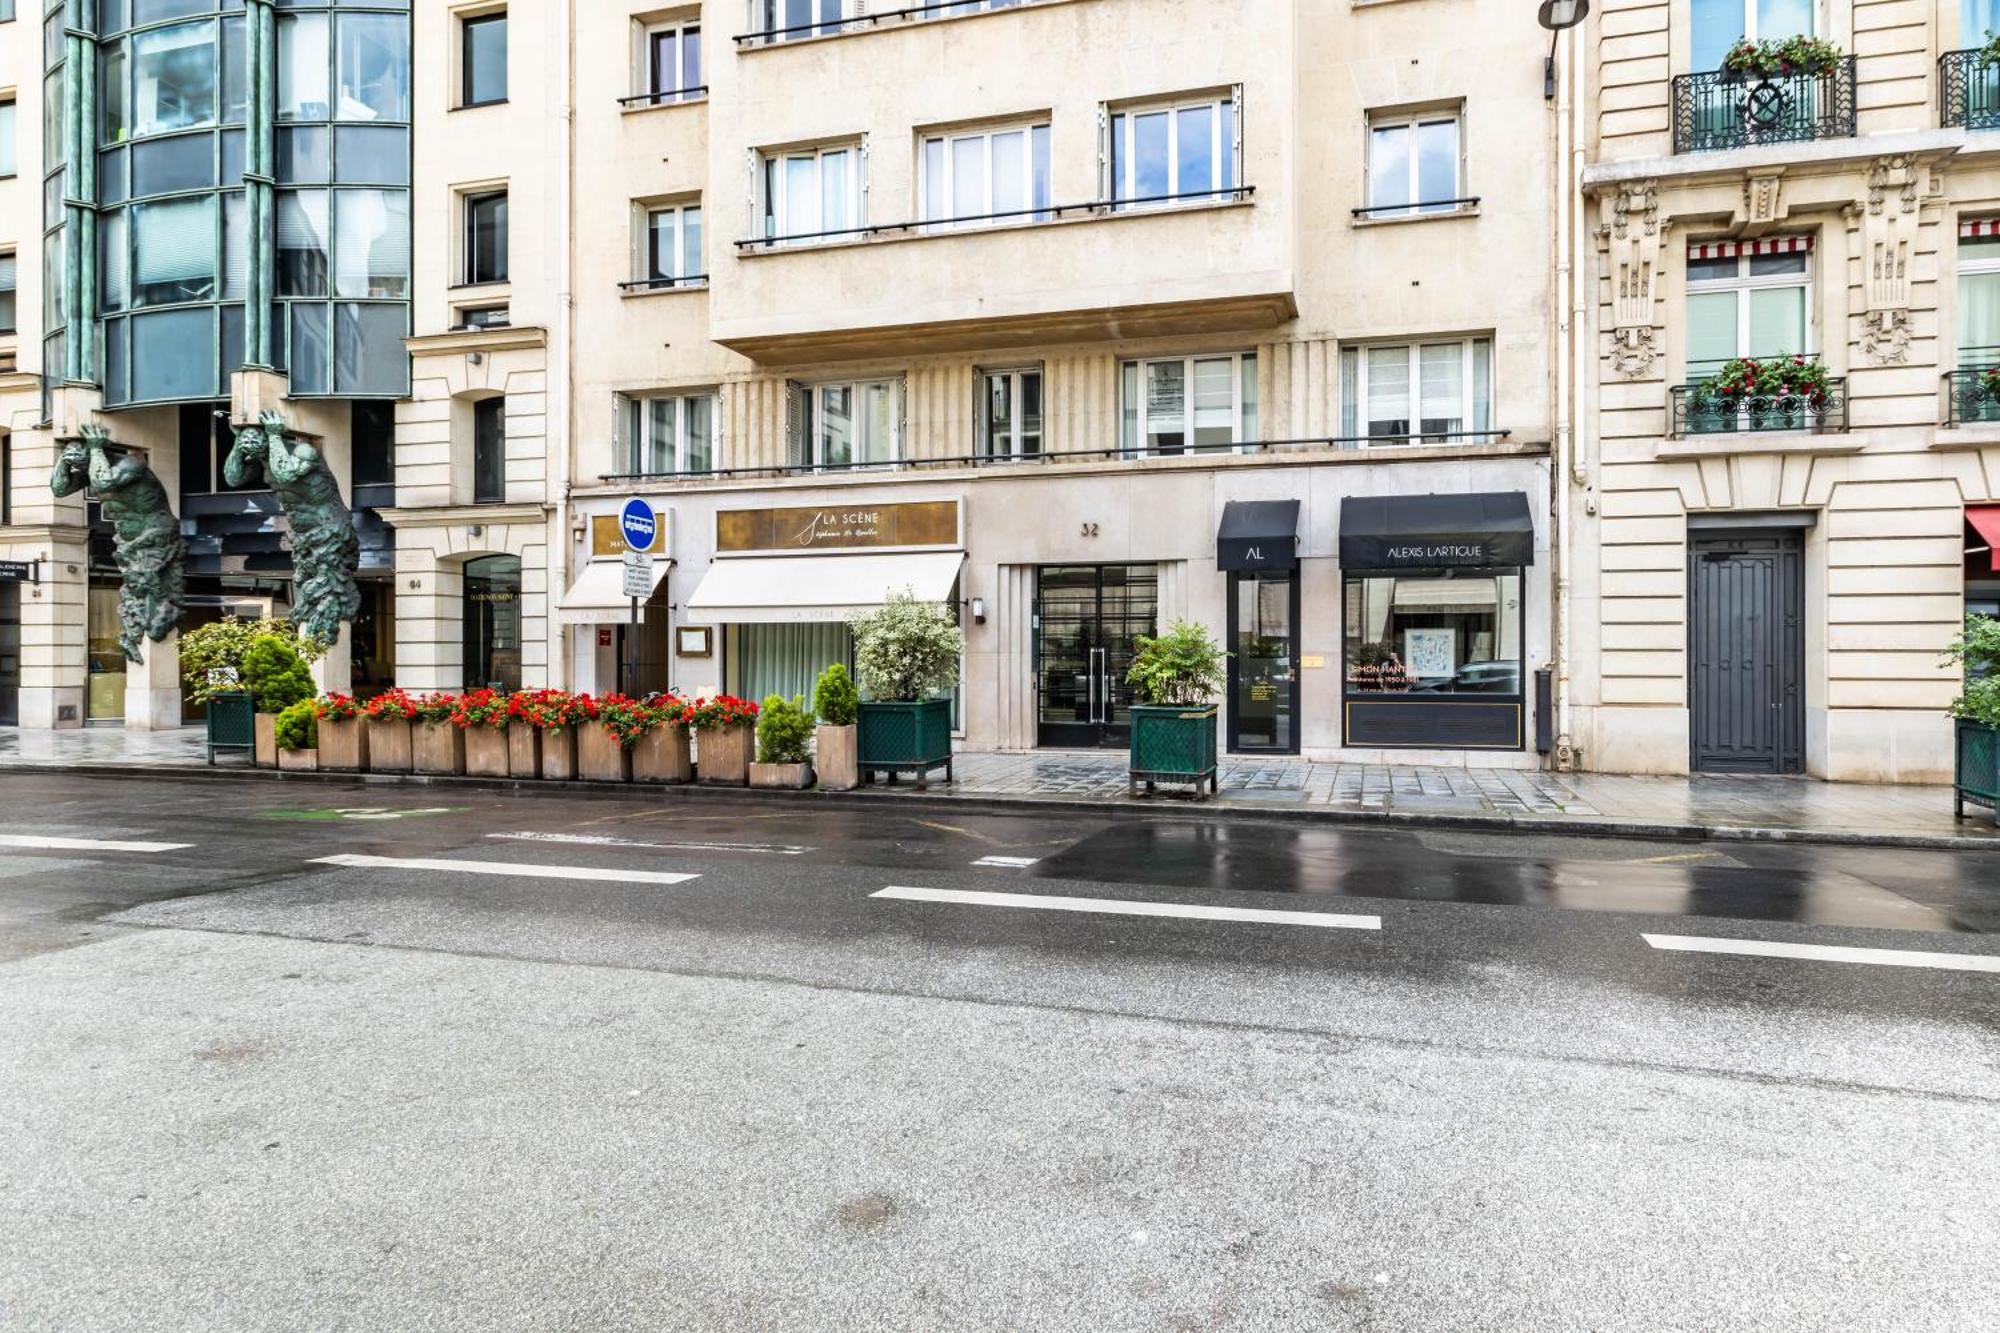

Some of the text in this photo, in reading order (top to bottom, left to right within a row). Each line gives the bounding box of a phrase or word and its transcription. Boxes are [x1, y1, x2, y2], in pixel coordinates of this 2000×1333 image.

[823, 511, 879, 524] LA SCÈNE
[1081, 523, 1099, 537] 32
[1246, 548, 1264, 559] AL
[1388, 546, 1482, 558] ALEXIS LARTIGUE
